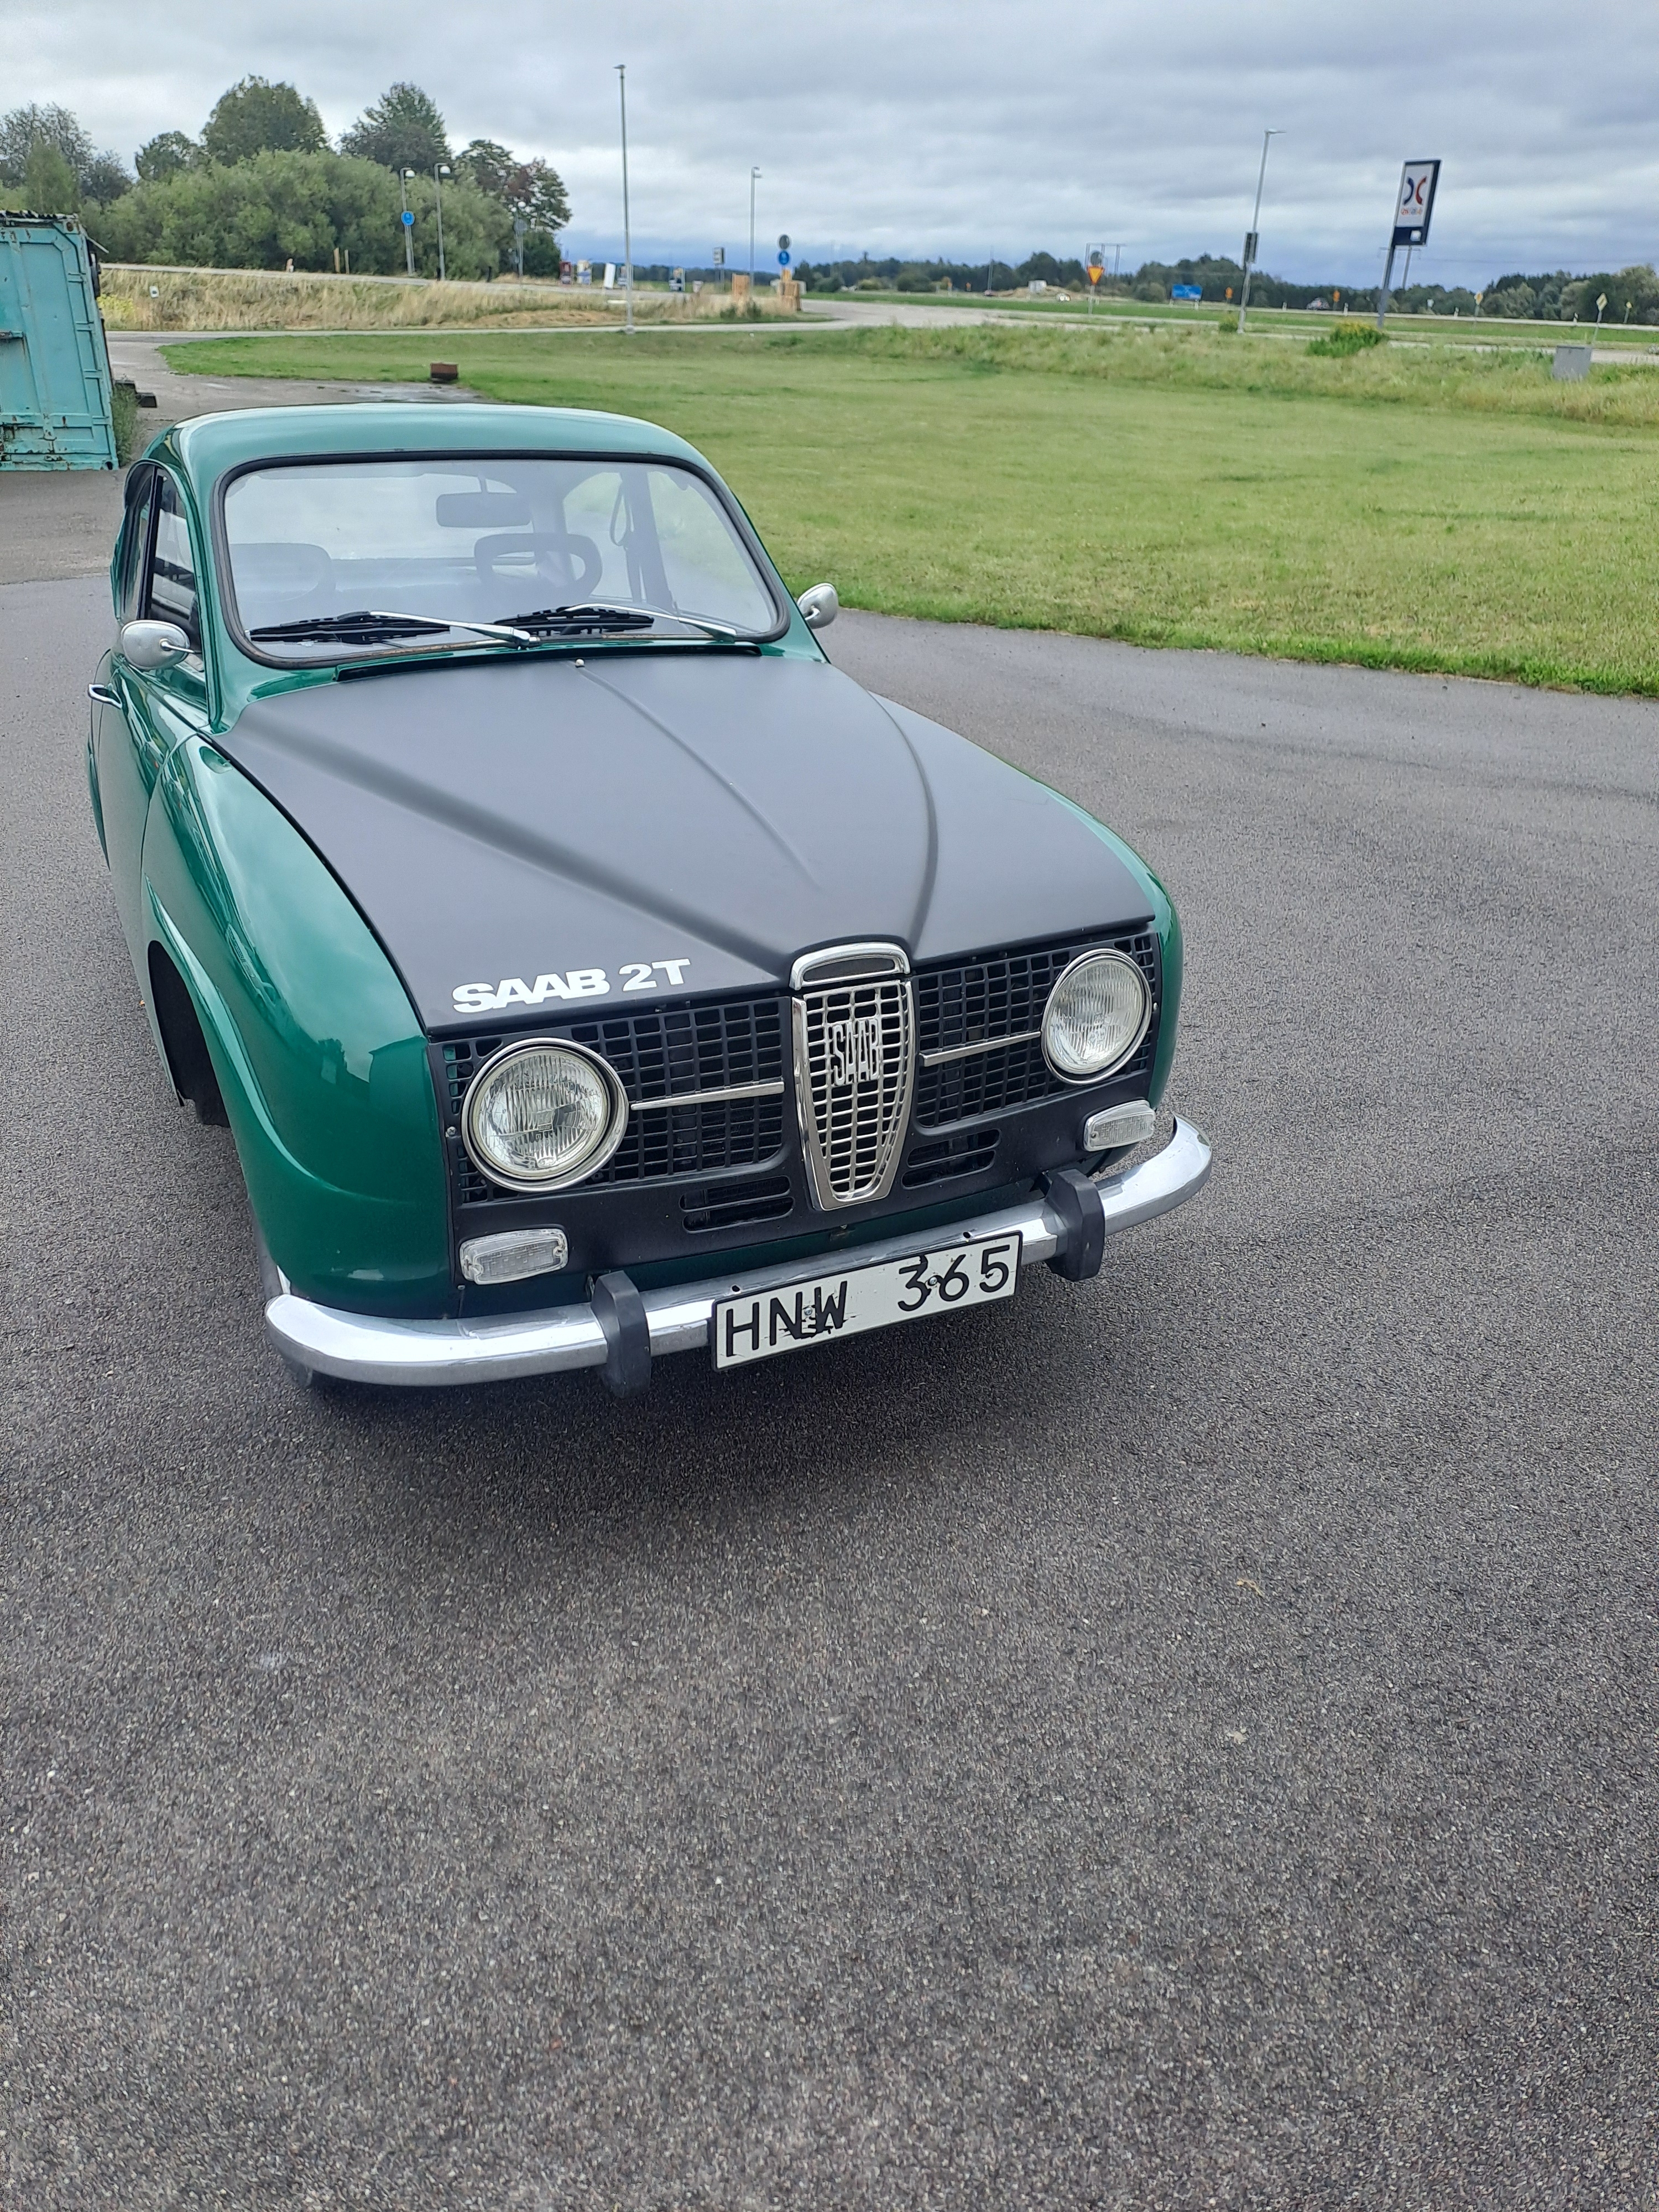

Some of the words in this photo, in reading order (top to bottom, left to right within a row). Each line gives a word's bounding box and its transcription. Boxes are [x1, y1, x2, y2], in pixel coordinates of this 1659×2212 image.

[452, 968, 611, 1013] SAAB
[618, 958, 691, 992] 2T
[833, 1019, 879, 1086] SAAB
[726, 1281, 848, 1357] HNW
[898, 1244, 1010, 1311] 365
